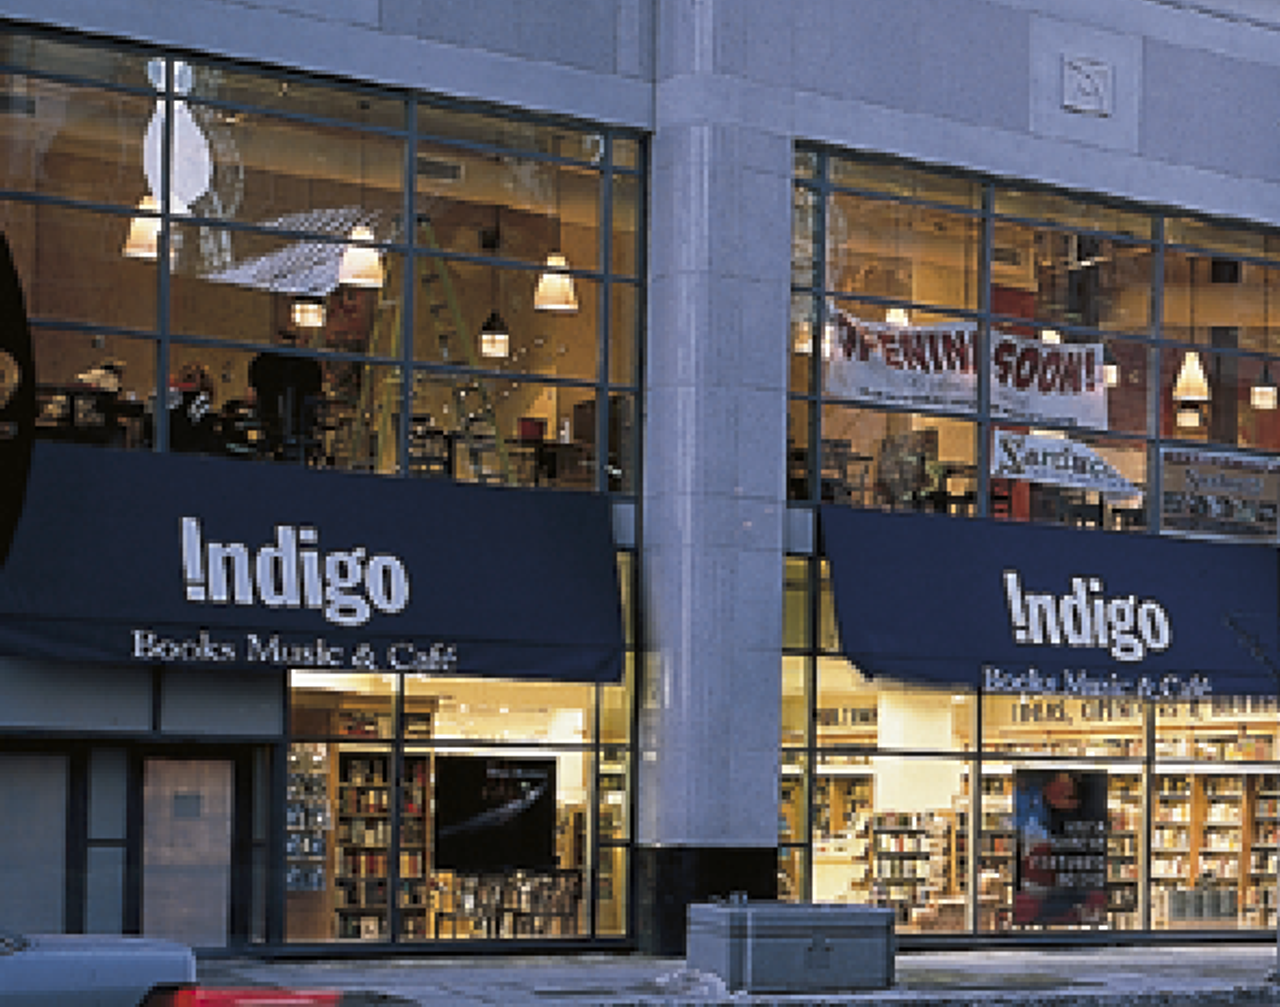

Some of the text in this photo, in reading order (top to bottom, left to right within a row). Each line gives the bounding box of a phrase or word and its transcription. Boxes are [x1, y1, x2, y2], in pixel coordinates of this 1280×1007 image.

[836, 311, 1097, 396] OPENIN SOON!
[180, 515, 410, 627] Indigo
[130, 628, 458, 671] Books Music & Café
[1002, 568, 1173, 662] Indigo
[981, 663, 1057, 693] Books
